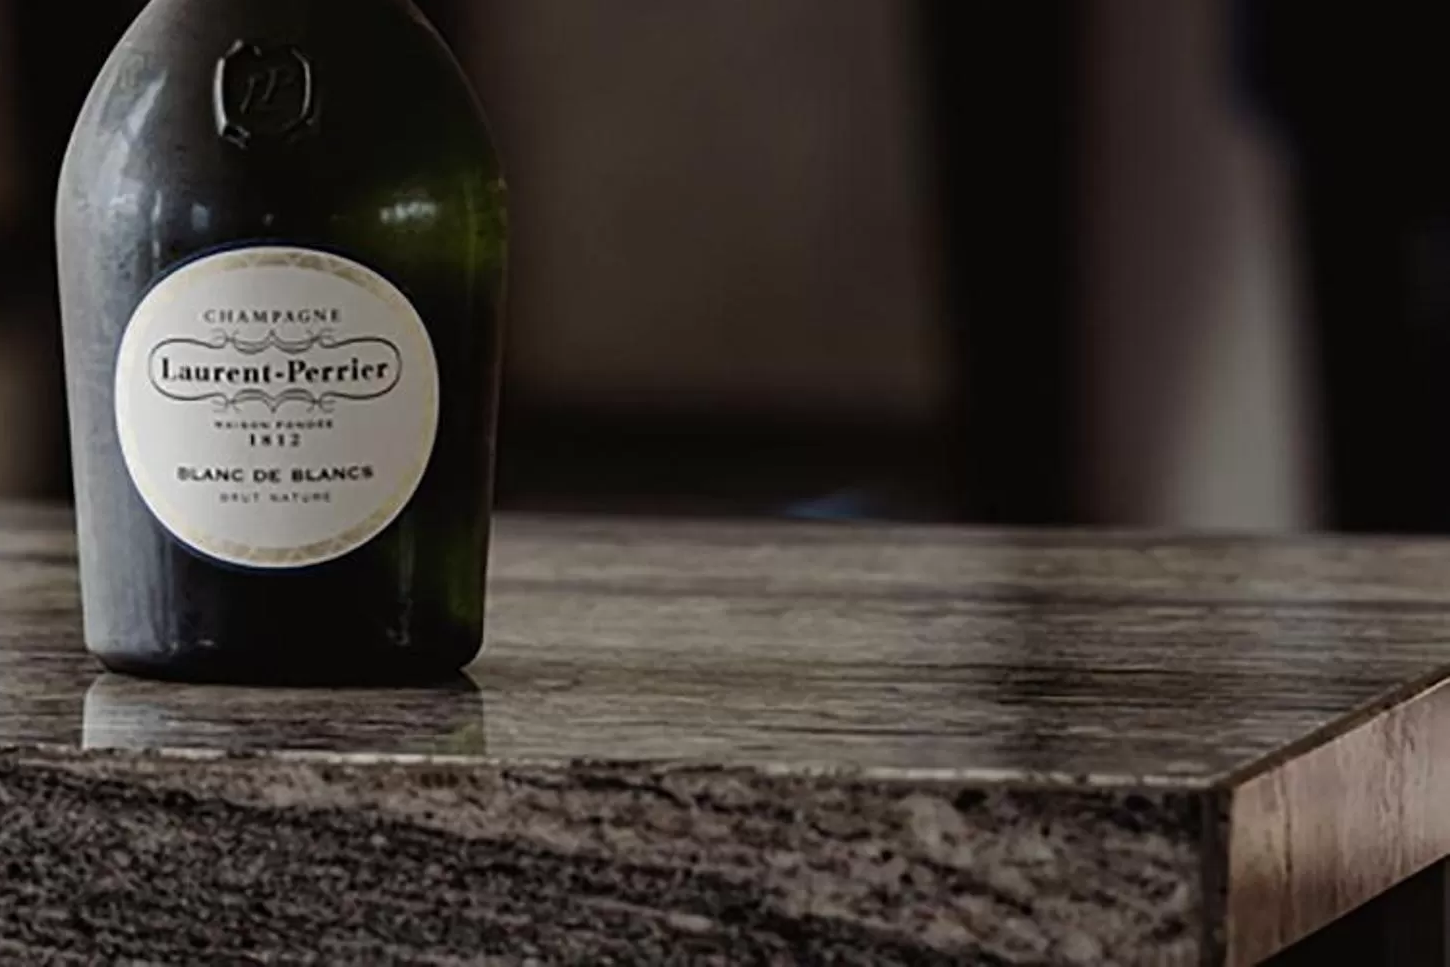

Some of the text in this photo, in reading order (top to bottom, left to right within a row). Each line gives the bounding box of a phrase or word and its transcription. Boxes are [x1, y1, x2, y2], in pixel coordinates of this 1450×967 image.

[203, 309, 343, 324] CHAMPAGNE
[161, 356, 389, 384] Laurent-Perrier
[249, 432, 302, 448] 1812
[176, 464, 374, 483] BLANC DE BLANCS
[219, 491, 332, 504] BRUT NATURE
